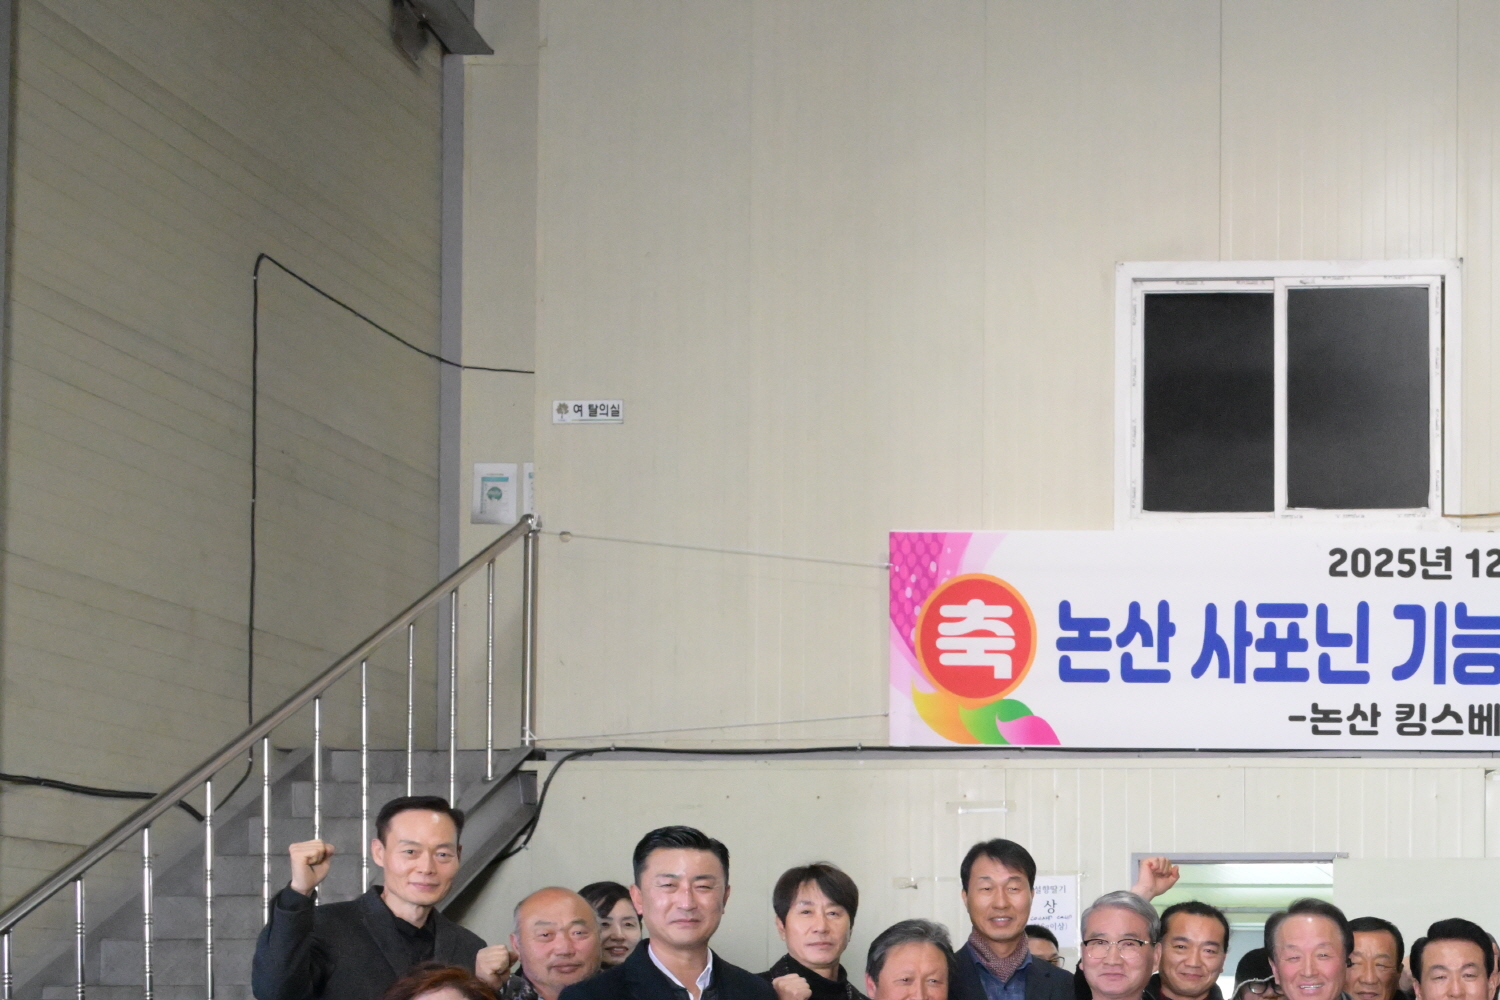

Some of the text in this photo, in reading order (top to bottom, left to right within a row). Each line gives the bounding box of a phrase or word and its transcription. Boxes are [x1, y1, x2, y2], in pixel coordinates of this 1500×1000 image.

[573, 403, 620, 417] 여 탈의실
[1329, 547, 1453, 580] 2025년
[936, 600, 1014, 681] 축
[1056, 599, 1176, 684] 논산
[1190, 600, 1371, 685] 사포닌
[1044, 899, 1057, 914] 상
